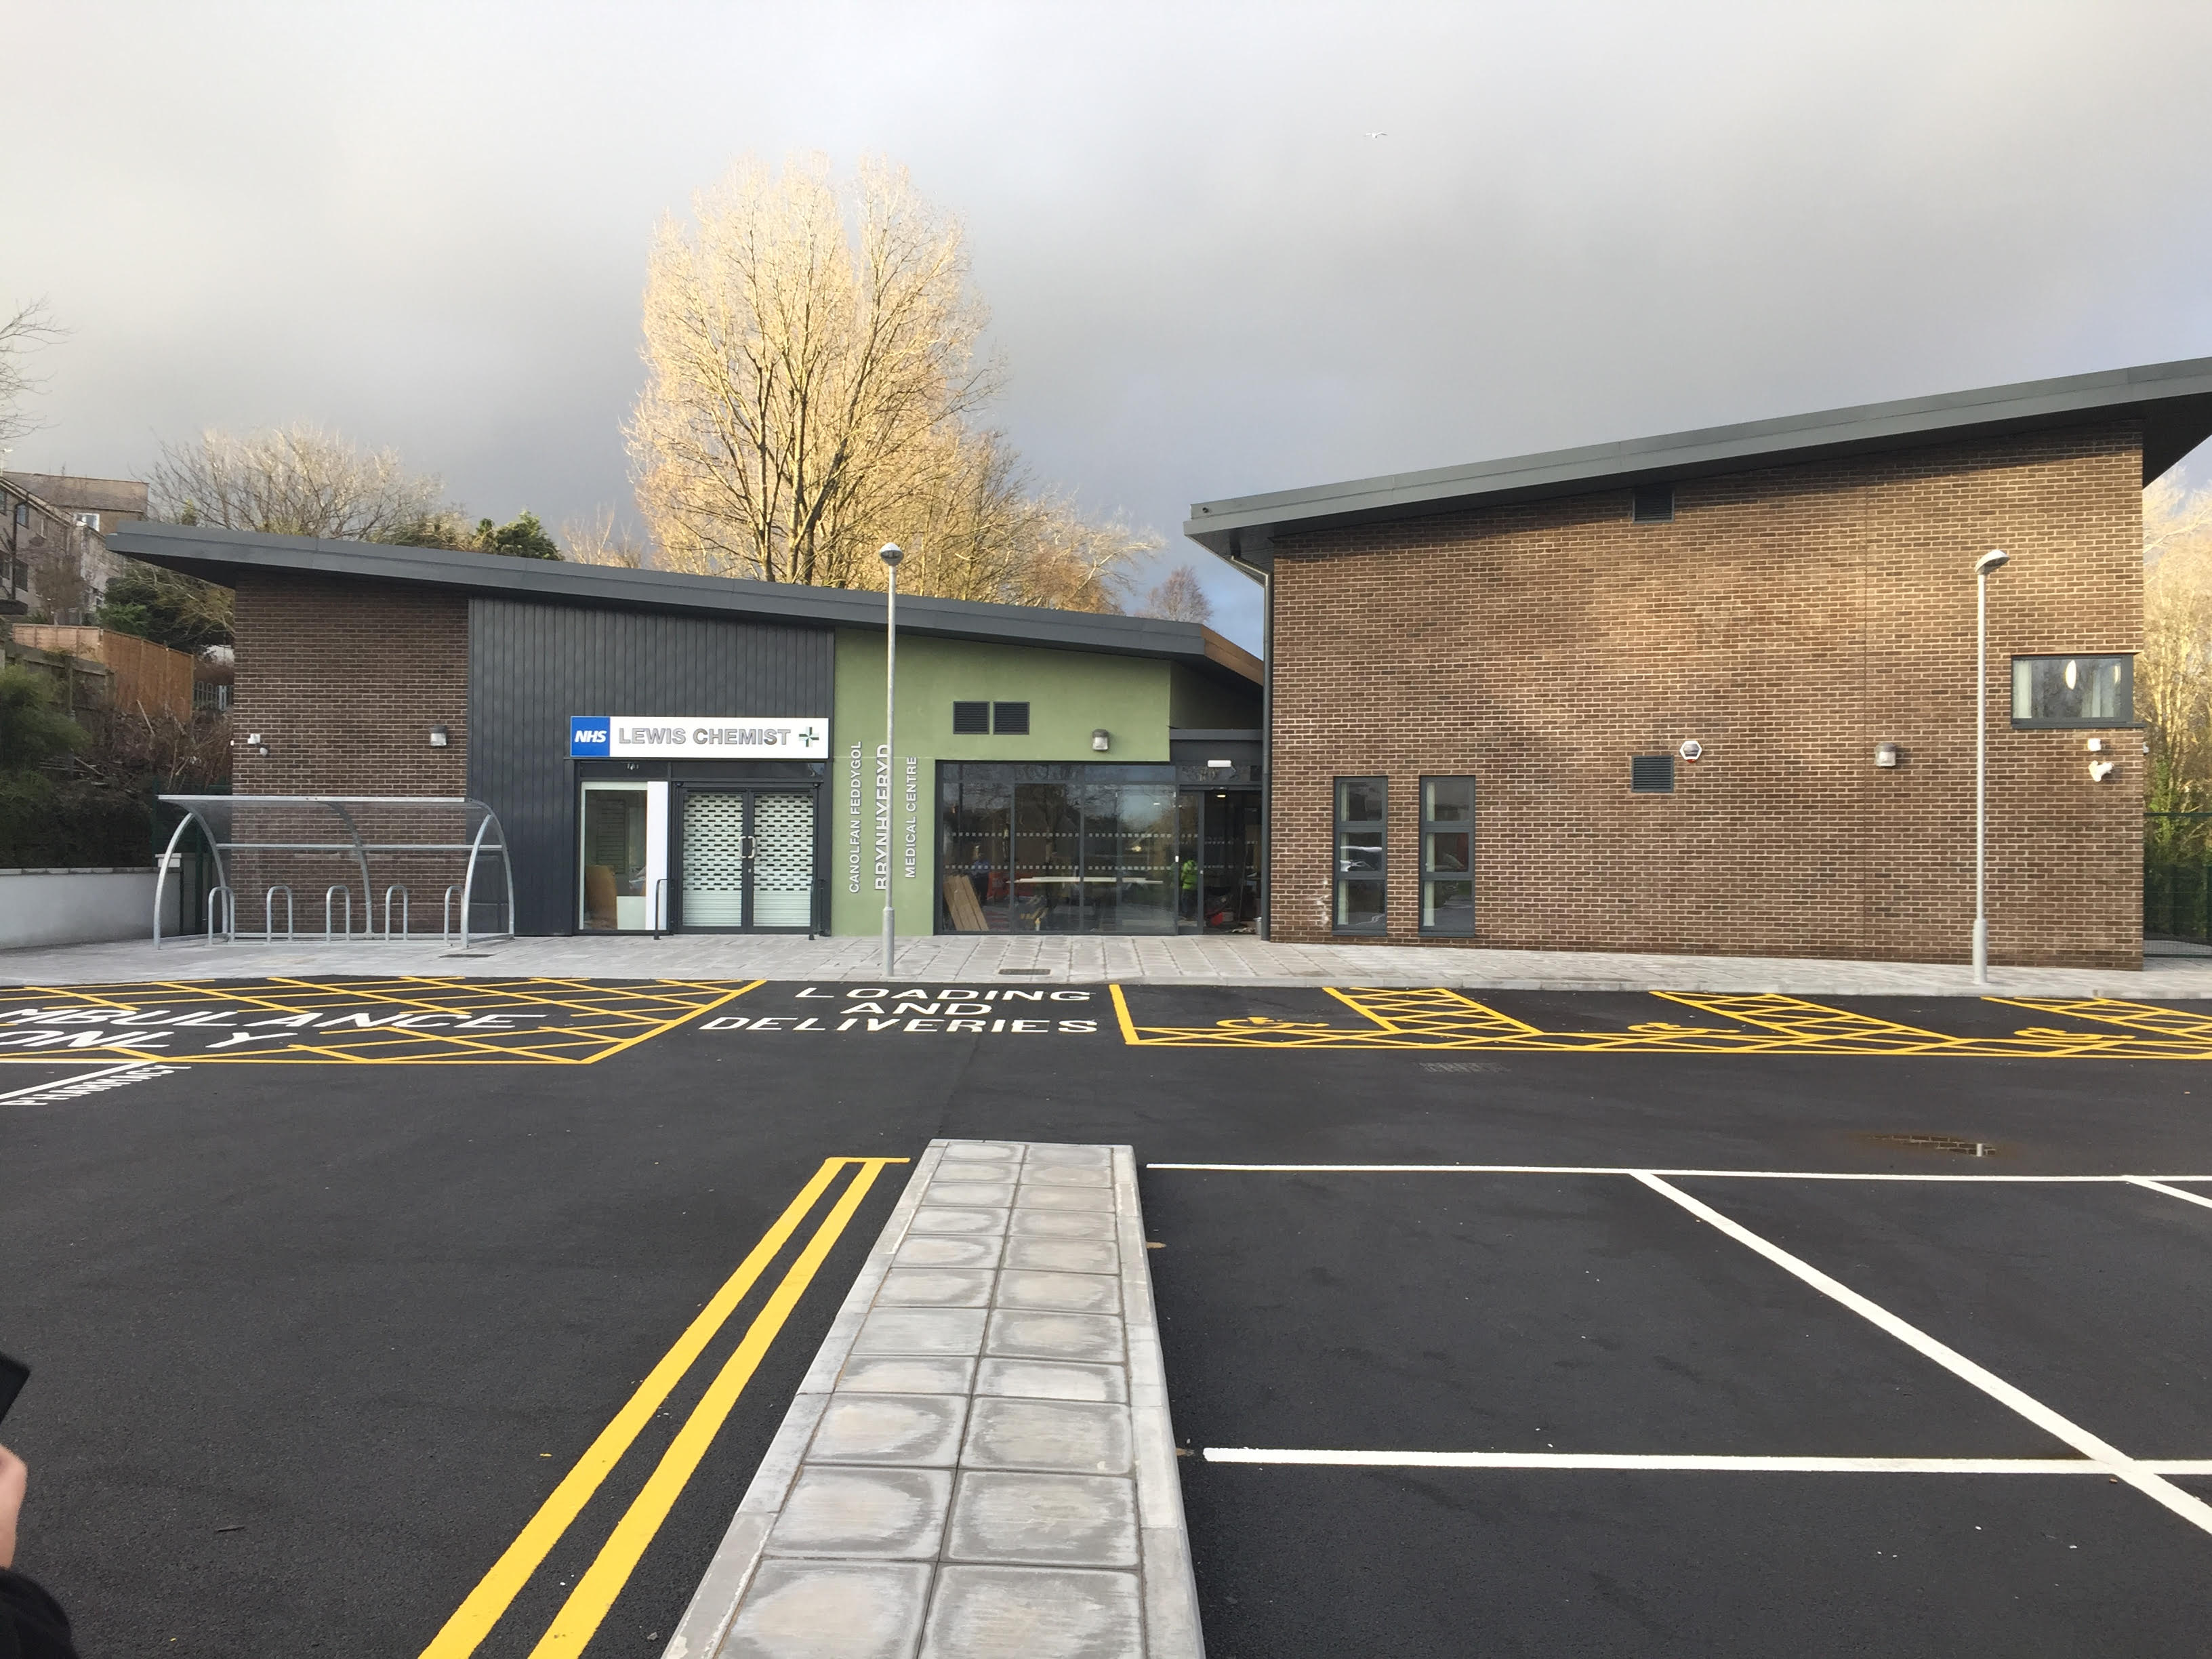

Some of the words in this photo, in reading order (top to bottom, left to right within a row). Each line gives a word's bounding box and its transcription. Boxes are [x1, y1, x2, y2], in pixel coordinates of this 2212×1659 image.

[575, 730, 607, 743] NHS
[618, 728, 686, 744] LEWIS
[693, 729, 791, 745] CHEMIST
[851, 741, 862, 815] FEDDYGOL
[906, 756, 918, 812] CENTRE
[849, 819, 861, 893] CANOLFAN
[905, 816, 916, 878] MEDICAL
[795, 987, 1091, 1001] LOADING
[840, 1002, 991, 1015] AND
[699, 1017, 1098, 1033] DELIVERIES
[0, 1065, 192, 1105] PHARMACY
